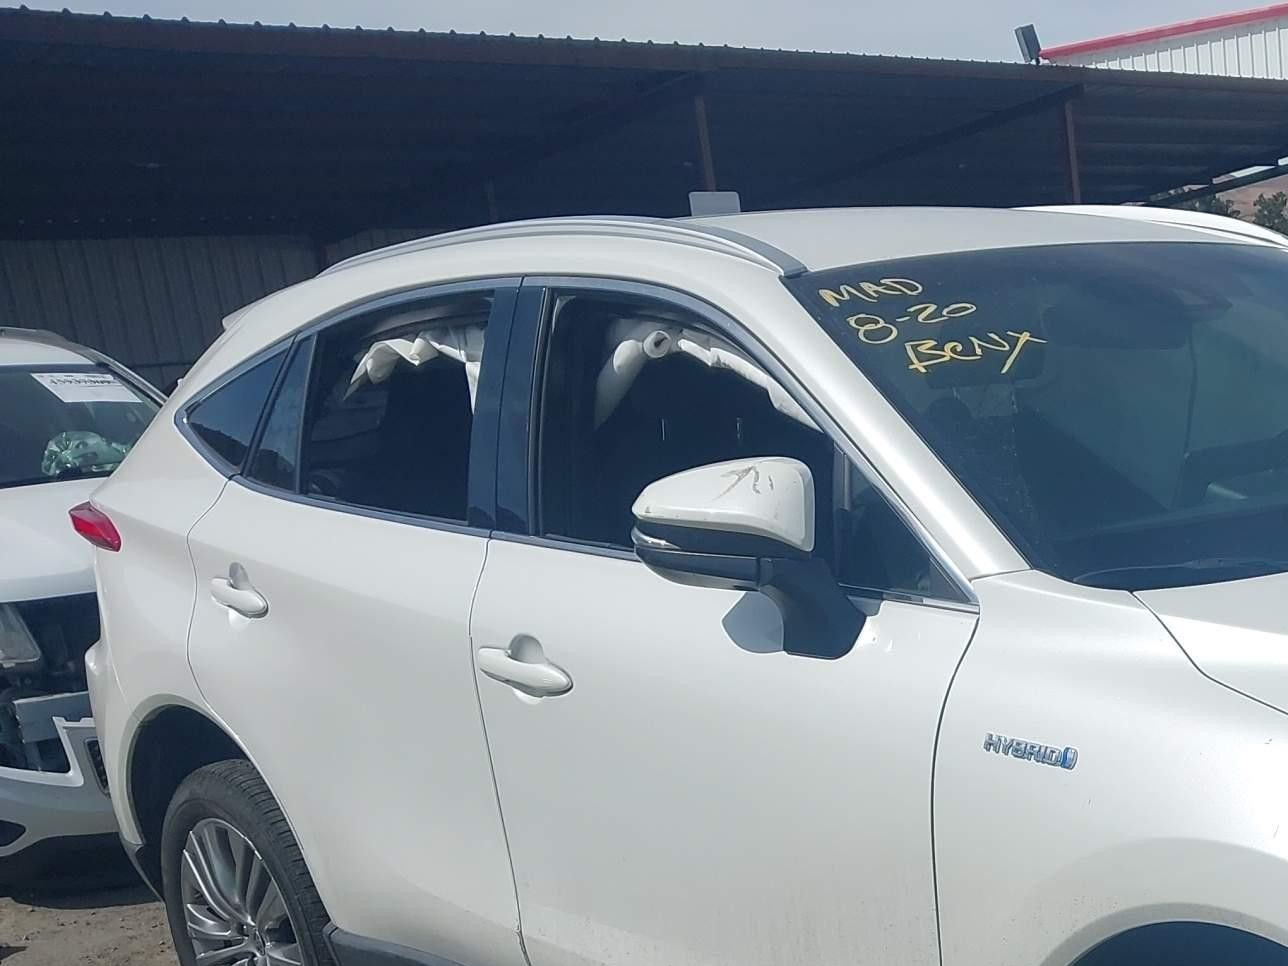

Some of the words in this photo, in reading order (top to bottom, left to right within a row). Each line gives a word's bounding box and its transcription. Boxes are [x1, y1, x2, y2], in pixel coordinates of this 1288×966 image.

[818, 278, 923, 308] MAD
[847, 303, 977, 344] 8-20
[983, 732, 1062, 767] HYBRID
